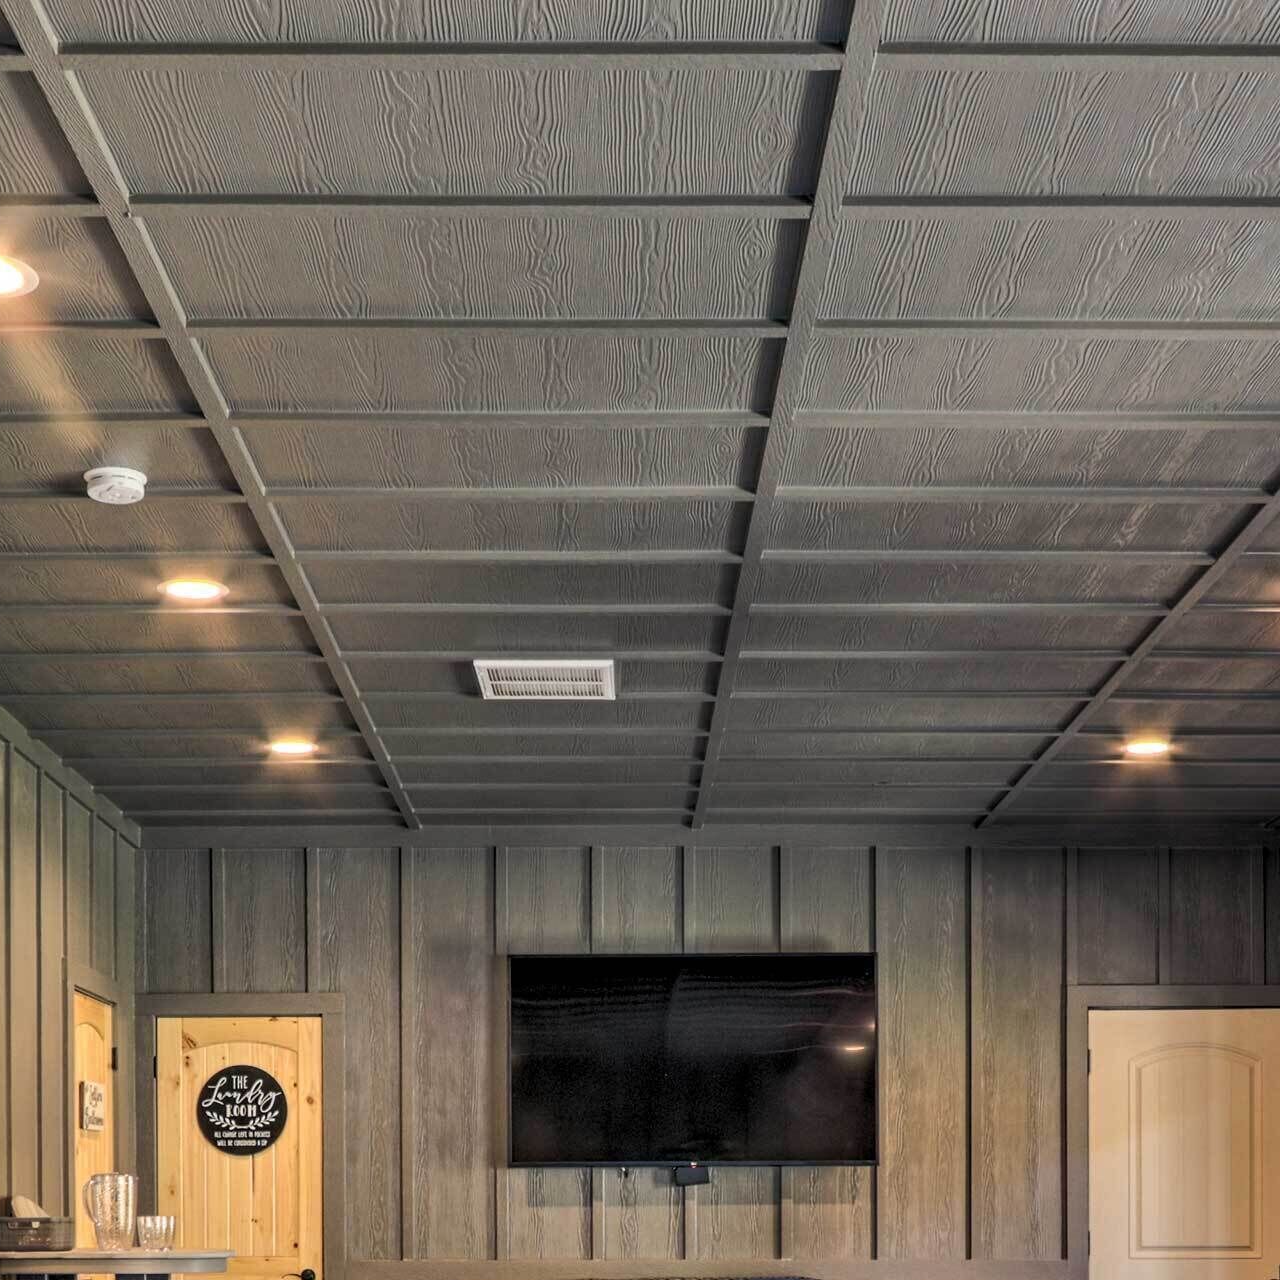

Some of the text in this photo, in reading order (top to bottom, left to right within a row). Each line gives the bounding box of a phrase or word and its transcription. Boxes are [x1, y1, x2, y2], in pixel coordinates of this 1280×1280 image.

[231, 1075, 248, 1089] THE
[201, 1077, 282, 1113] Laundry
[225, 1104, 257, 1118] ROOM
